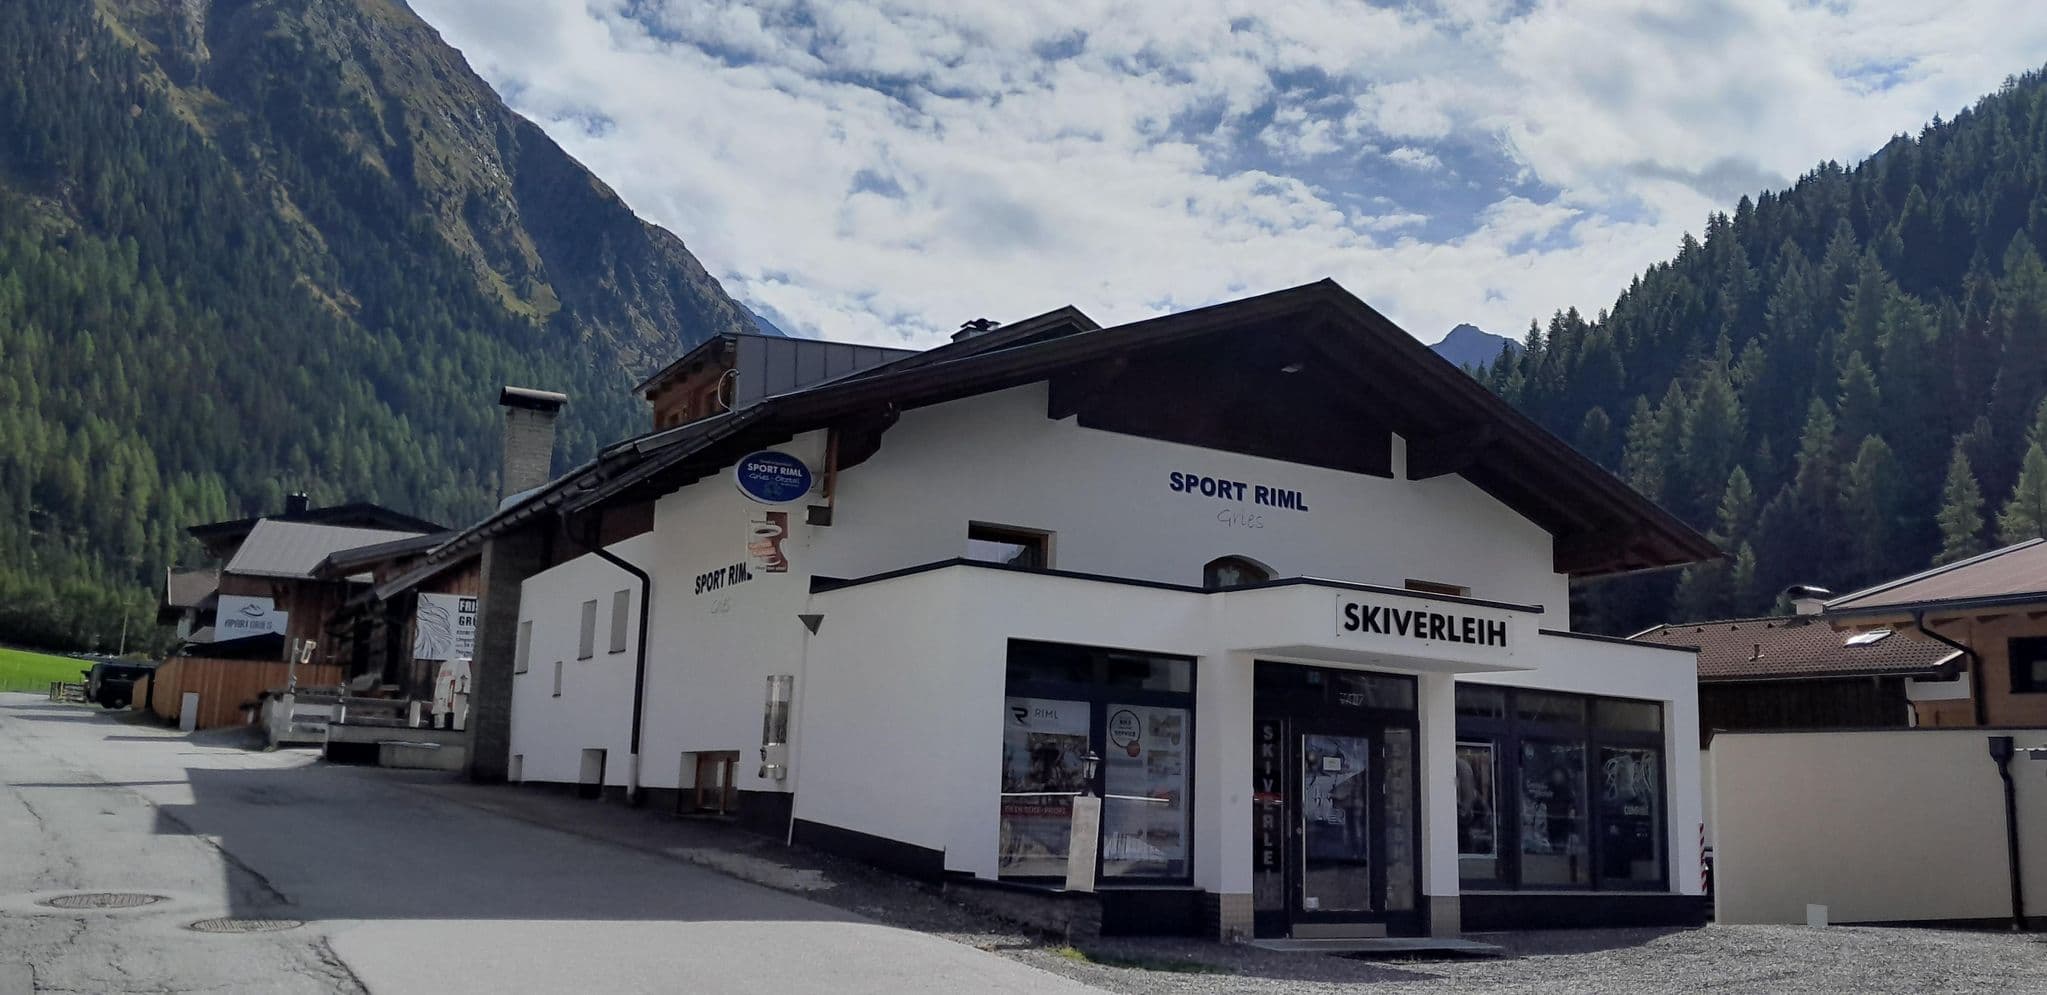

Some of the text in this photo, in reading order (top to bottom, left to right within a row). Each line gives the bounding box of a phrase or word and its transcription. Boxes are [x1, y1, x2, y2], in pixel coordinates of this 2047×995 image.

[747, 462, 779, 474] SPORT
[780, 467, 803, 477] RIML
[1168, 471, 1309, 512] SPORT RIML
[1217, 508, 1265, 530] Gries
[695, 567, 726, 595] SPORT
[1343, 602, 1508, 648] SKIVERLEIH
[1034, 708, 1059, 720] RIML
